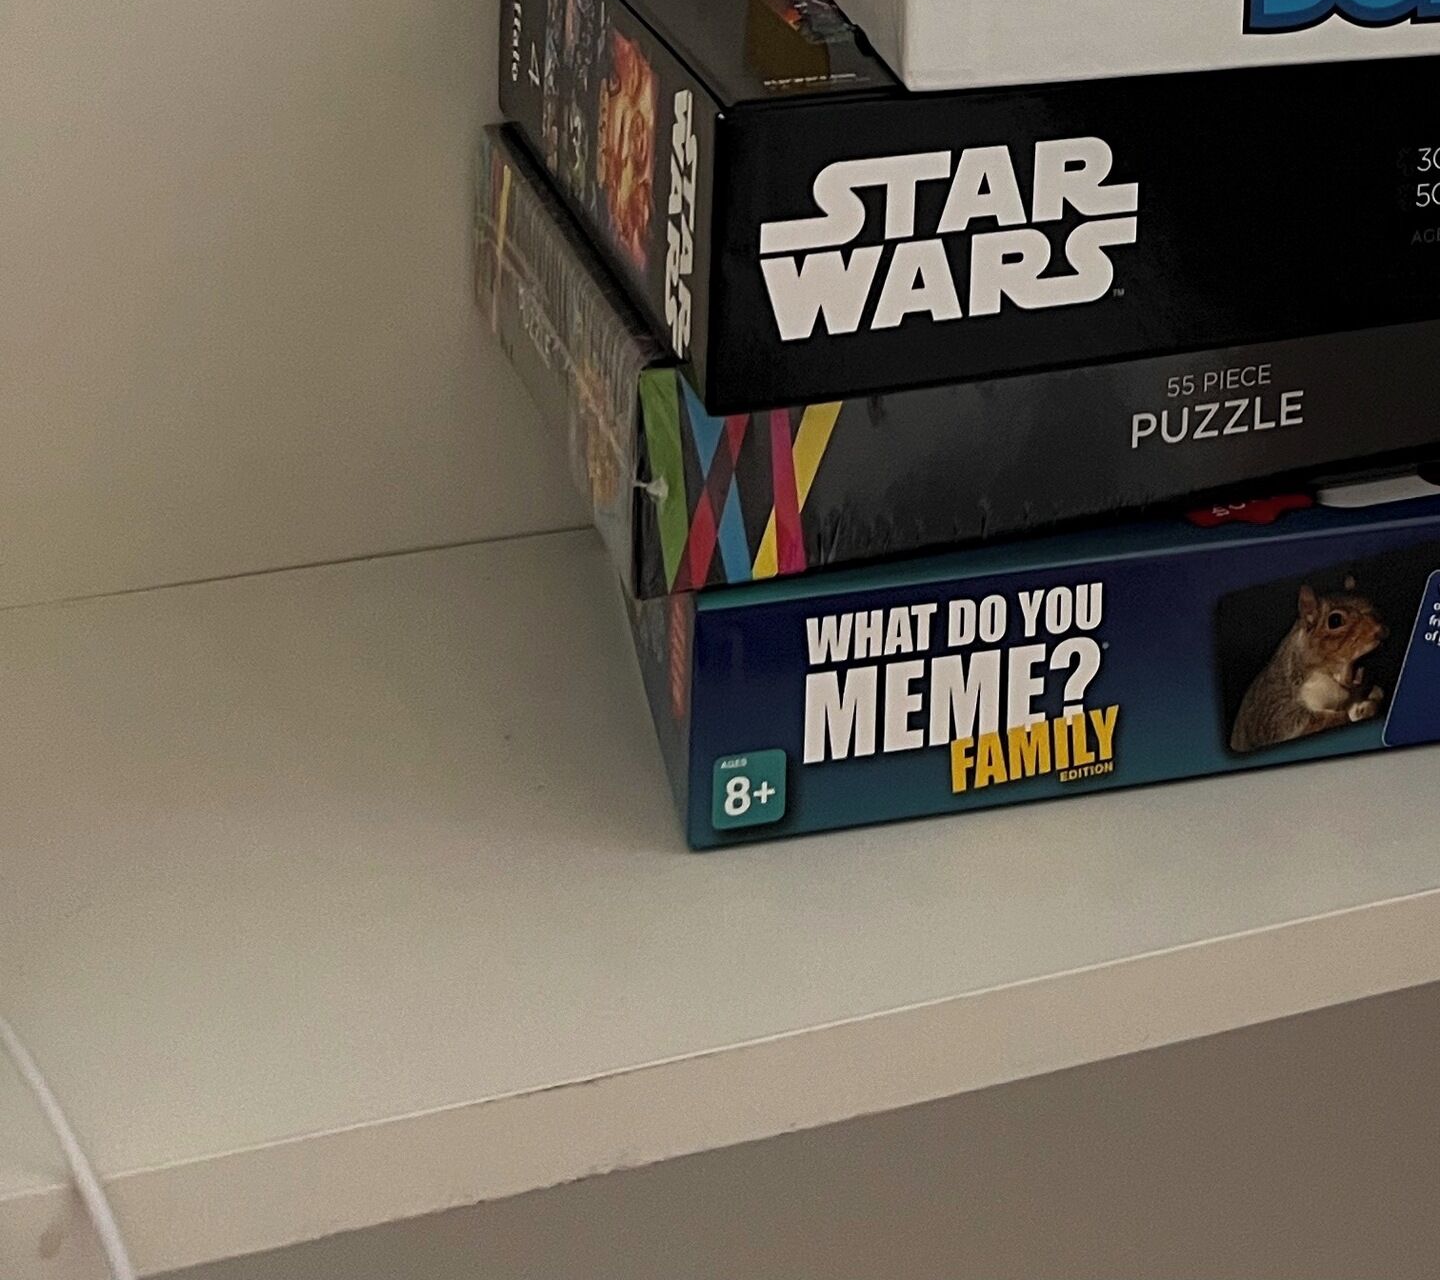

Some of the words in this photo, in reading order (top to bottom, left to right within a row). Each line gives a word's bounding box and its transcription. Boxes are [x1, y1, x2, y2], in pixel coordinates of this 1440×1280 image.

[759, 135, 1140, 255] STAR
[759, 215, 1138, 342] WARS
[1166, 374, 1196, 398] 55
[1203, 363, 1272, 393] PIECE
[1130, 389, 1305, 449] PUZZLE
[805, 601, 938, 666] WHAT
[947, 593, 1008, 648] DO
[1018, 582, 1104, 637] YOU
[1424, 630, 1439, 641] of
[803, 636, 1101, 765] MEME?
[950, 703, 1120, 794] FAMILY
[1059, 759, 1114, 783] EDITION
[723, 775, 777, 817] 8+
